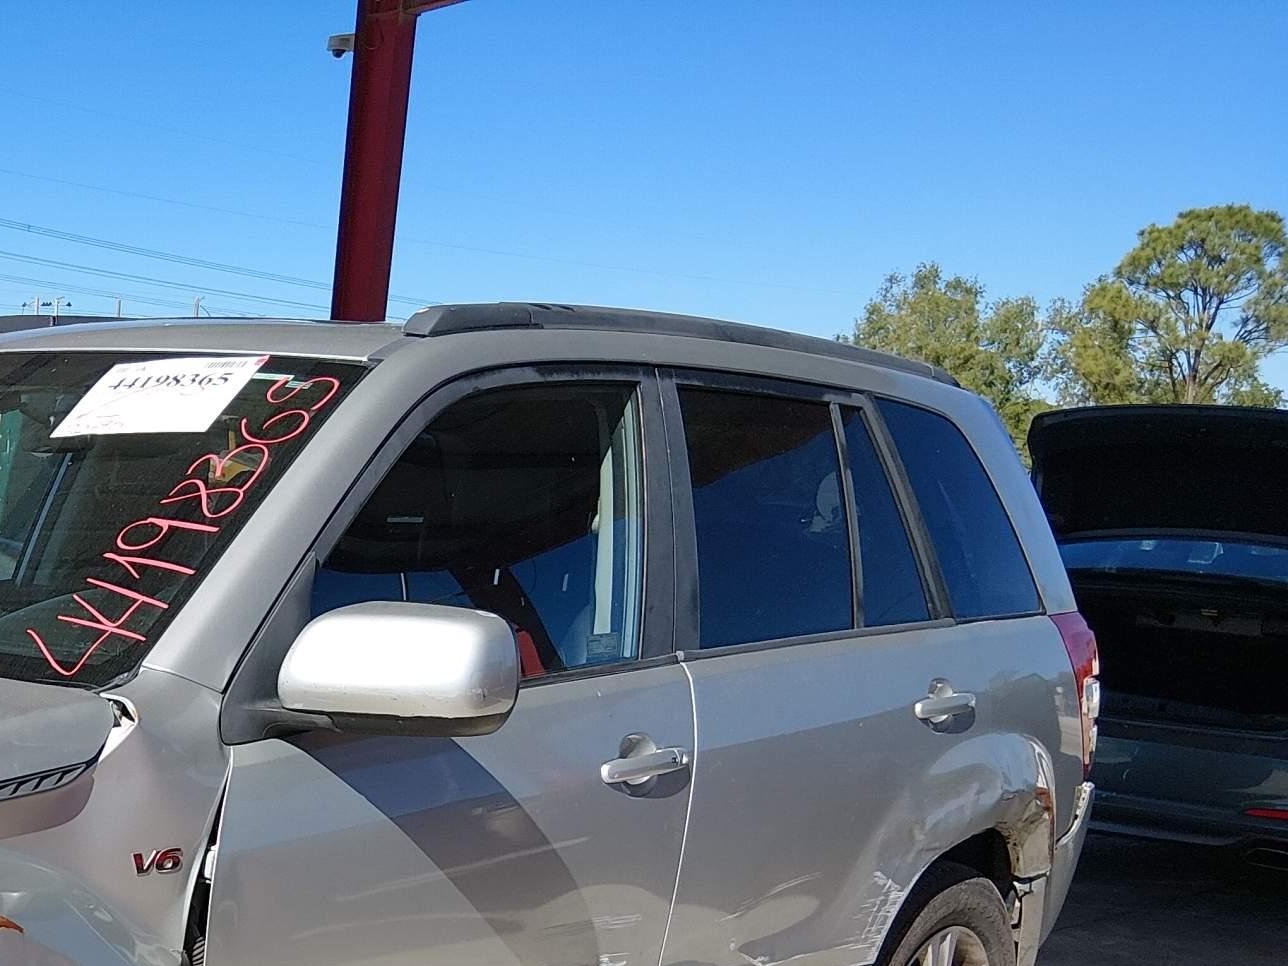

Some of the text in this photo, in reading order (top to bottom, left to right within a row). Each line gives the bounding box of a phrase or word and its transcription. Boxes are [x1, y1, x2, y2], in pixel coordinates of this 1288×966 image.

[108, 372, 234, 390] 44198365
[26, 376, 341, 677] 44198365
[131, 846, 183, 877] V6
